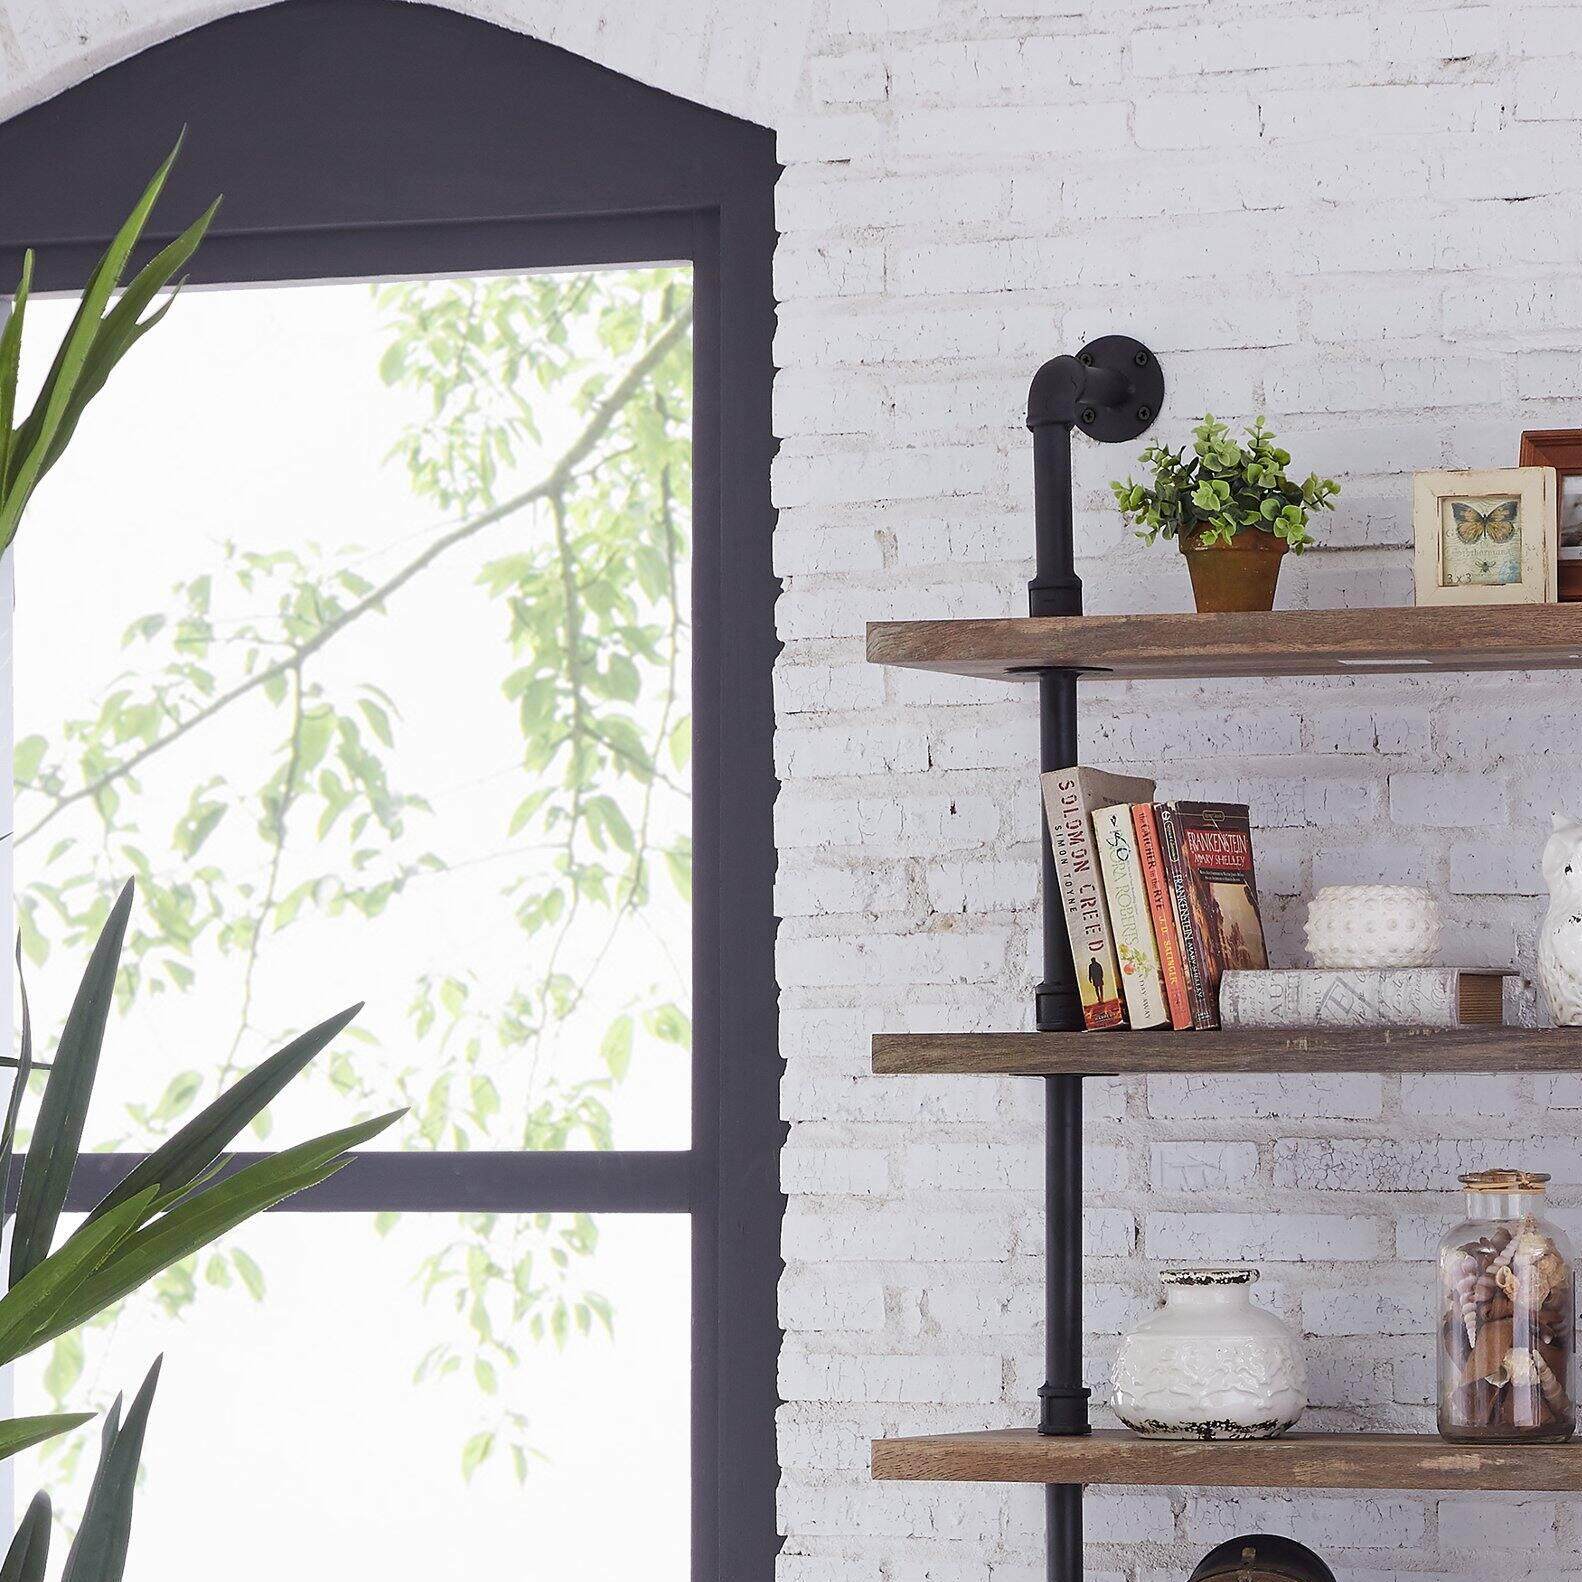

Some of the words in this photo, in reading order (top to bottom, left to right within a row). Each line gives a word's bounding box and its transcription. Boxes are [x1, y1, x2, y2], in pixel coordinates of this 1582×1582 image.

[1447, 574, 1453, 583] 3
[1466, 573, 1471, 582] 3
[1055, 825, 1069, 866] SIMON
[1063, 873, 1077, 913] TOYNE
[1058, 779, 1091, 873] SOLOMON
[1078, 884, 1105, 953] CREED
[1141, 824, 1156, 868] CATCHER
[1154, 890, 1164, 910] RYE
[1187, 832, 1247, 853] FRANKENSTEIN
[1195, 853, 1214, 866] MARY
[1216, 855, 1245, 867] SHELLEY
[1115, 884, 1139, 945] ROBERTS
[1173, 874, 1193, 941] FRANKENSTEIN
[1163, 940, 1177, 985] SALINGER
[1187, 942, 1197, 966] MARY
[1192, 966, 1203, 998] SHELLEY
